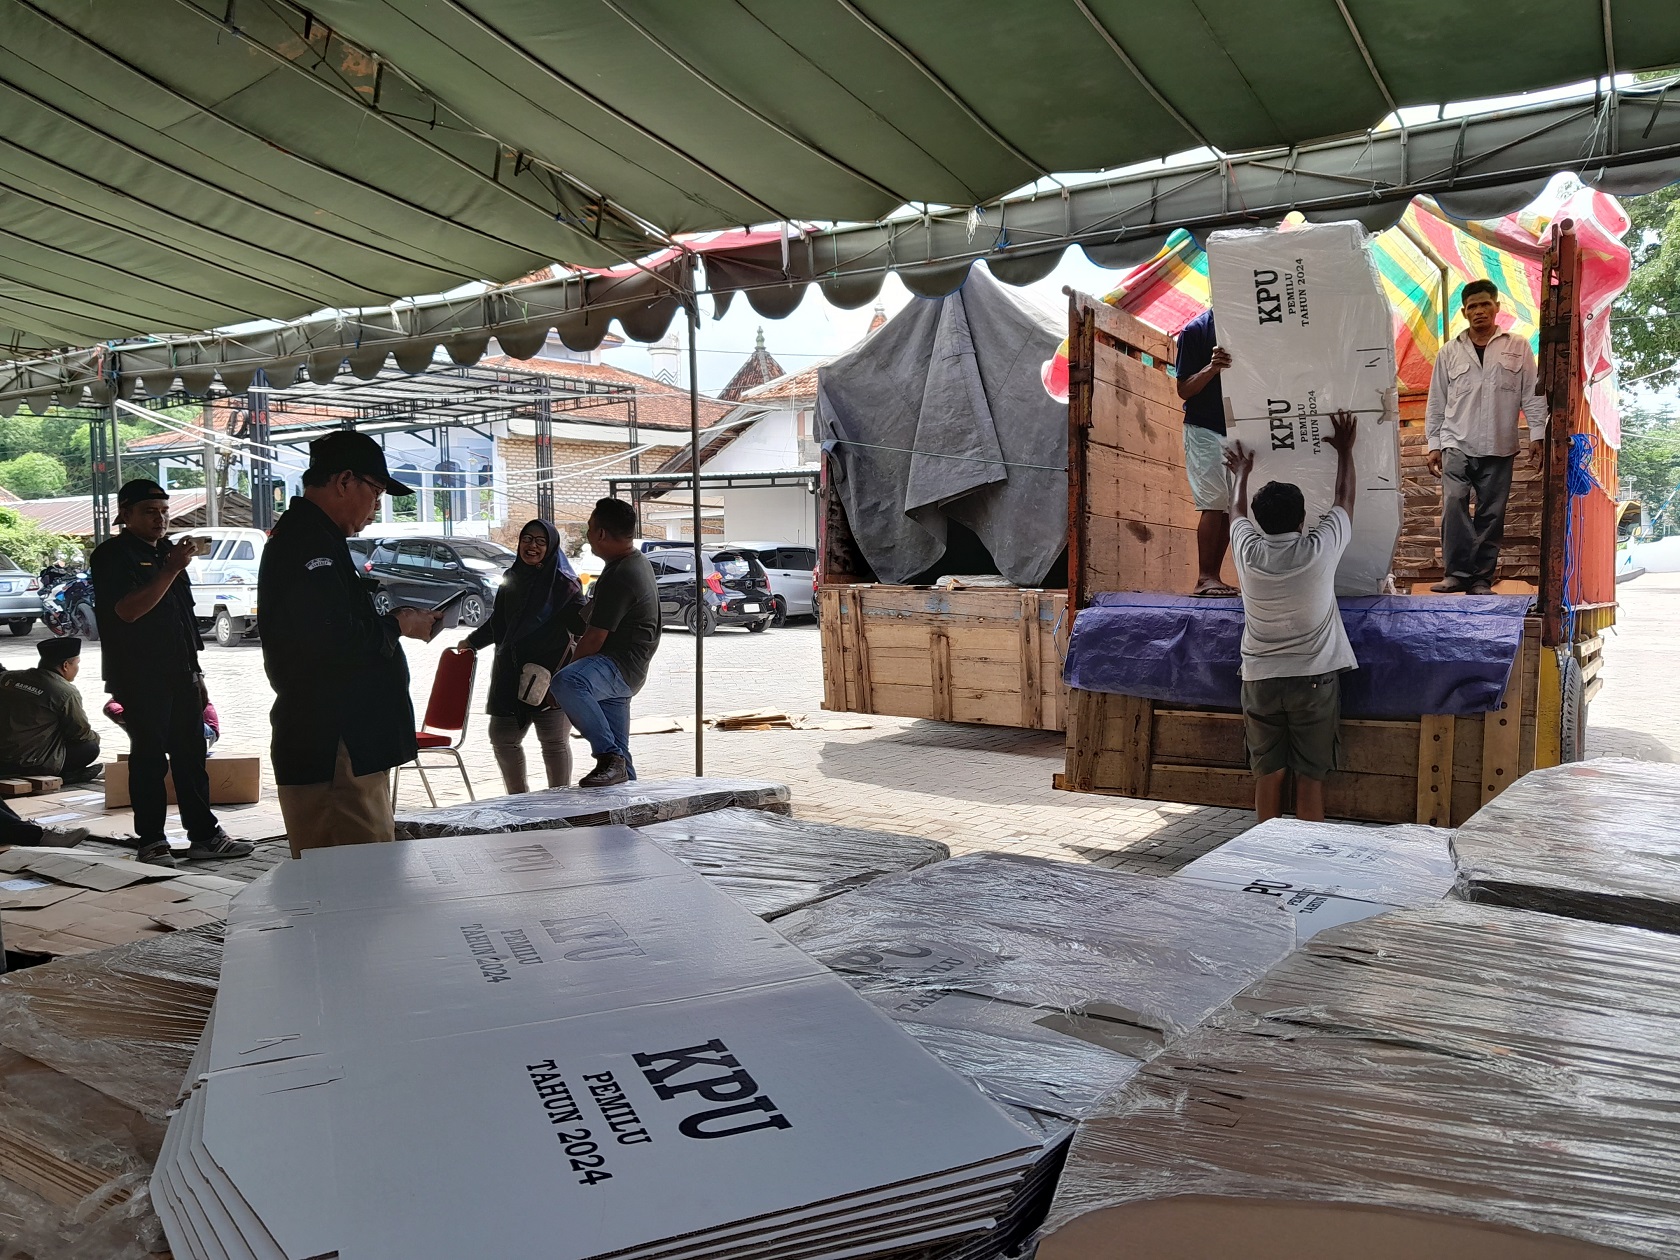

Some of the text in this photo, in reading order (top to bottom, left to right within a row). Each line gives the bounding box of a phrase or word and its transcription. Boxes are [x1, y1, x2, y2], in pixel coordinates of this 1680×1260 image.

[1253, 269, 1283, 326] KPU
[1285, 273, 1296, 315] PEMILU
[1296, 258, 1309, 327] TAHUN 2024
[1267, 398, 1295, 451] KPU
[1298, 403, 1308, 443] PEMILU
[1308, 390, 1321, 455] TAHUN 2024
[460, 923, 512, 984] TAHUN 2024
[500, 928, 544, 965] PEMILU
[582, 1070, 653, 1145] PEMILU
[631, 1038, 793, 1140] KPU
[526, 1059, 613, 1186] TAHUN 2024
